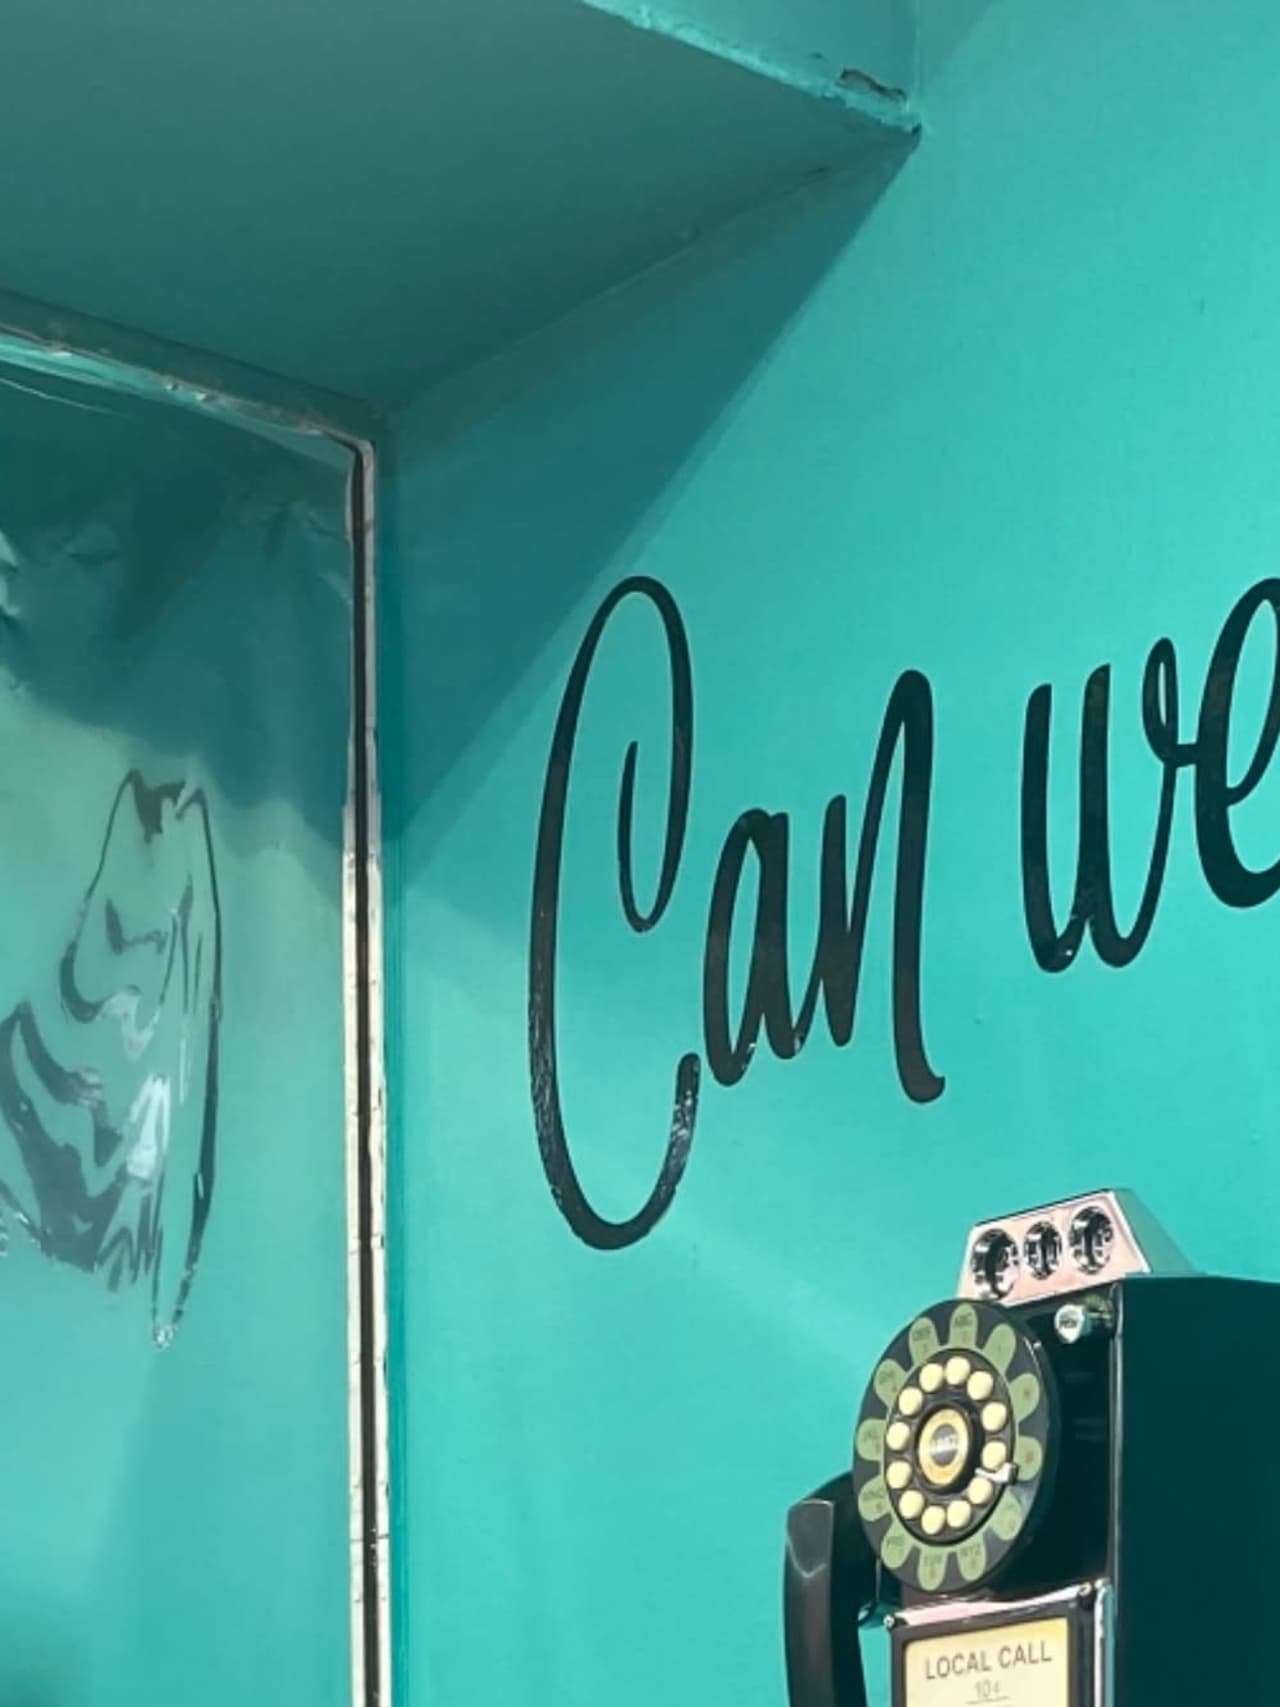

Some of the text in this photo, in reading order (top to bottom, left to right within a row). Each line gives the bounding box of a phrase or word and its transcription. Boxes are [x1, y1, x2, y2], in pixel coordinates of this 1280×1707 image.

[527, 575, 946, 1251] Can
[925, 1641, 1052, 1680] LOCAL CALL
